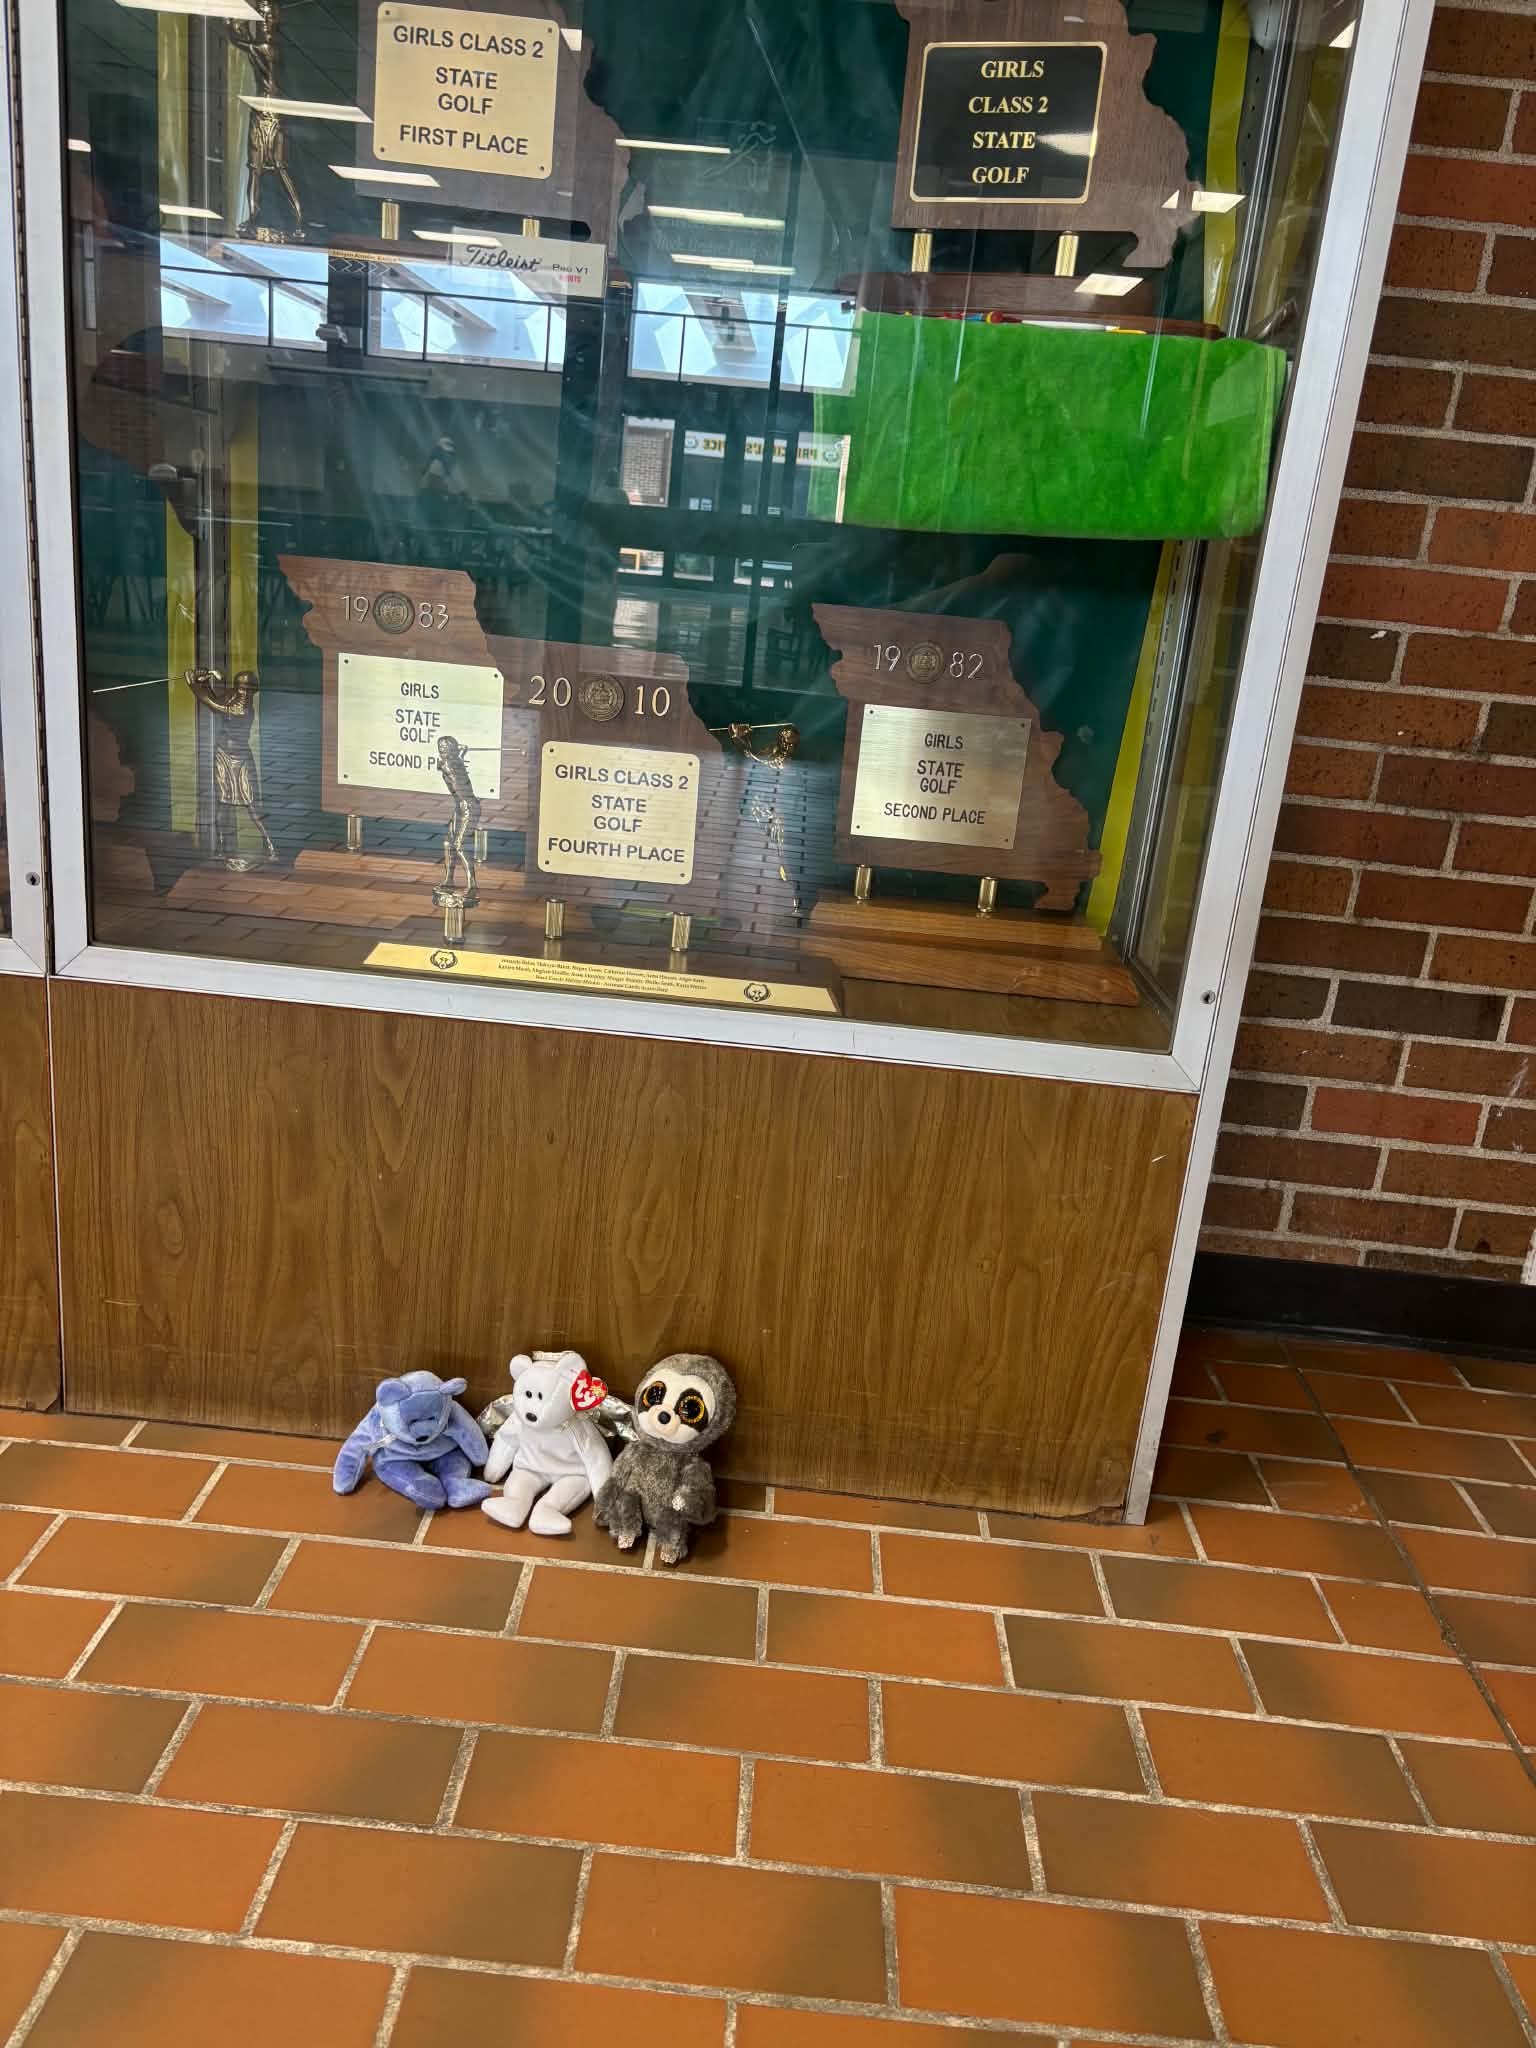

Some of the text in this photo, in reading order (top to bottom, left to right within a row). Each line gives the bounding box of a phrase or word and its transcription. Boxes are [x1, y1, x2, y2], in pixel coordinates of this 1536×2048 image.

[393, 25, 544, 58] GIRLS CLASS 2
[436, 66, 498, 90] STATE
[981, 60, 1045, 78] GIRLS
[438, 93, 493, 114] GOLF
[968, 96, 1049, 113] CLASS 2
[400, 124, 528, 155] FIRST PLACE
[972, 132, 1036, 149] STATE
[972, 166, 1030, 184] GOLF
[466, 244, 540, 273] Titleist
[340, 595, 449, 630] 19 83
[873, 644, 984, 679] 19 82
[400, 682, 440, 699] GIRLS
[528, 675, 671, 717] 20 10
[395, 708, 441, 727] STATE
[399, 726, 437, 744] GOLF
[924, 732, 964, 750] GIRLS
[369, 751, 422, 769] SECOND
[917, 760, 965, 778] STATE
[555, 764, 689, 790] GIRLS CLASS 2
[920, 777, 957, 794] GOLF
[591, 794, 648, 813] STATE
[884, 802, 987, 825] SECOND PLACE
[593, 815, 643, 833] GOLF
[548, 837, 686, 863] FOURTH PLACE
